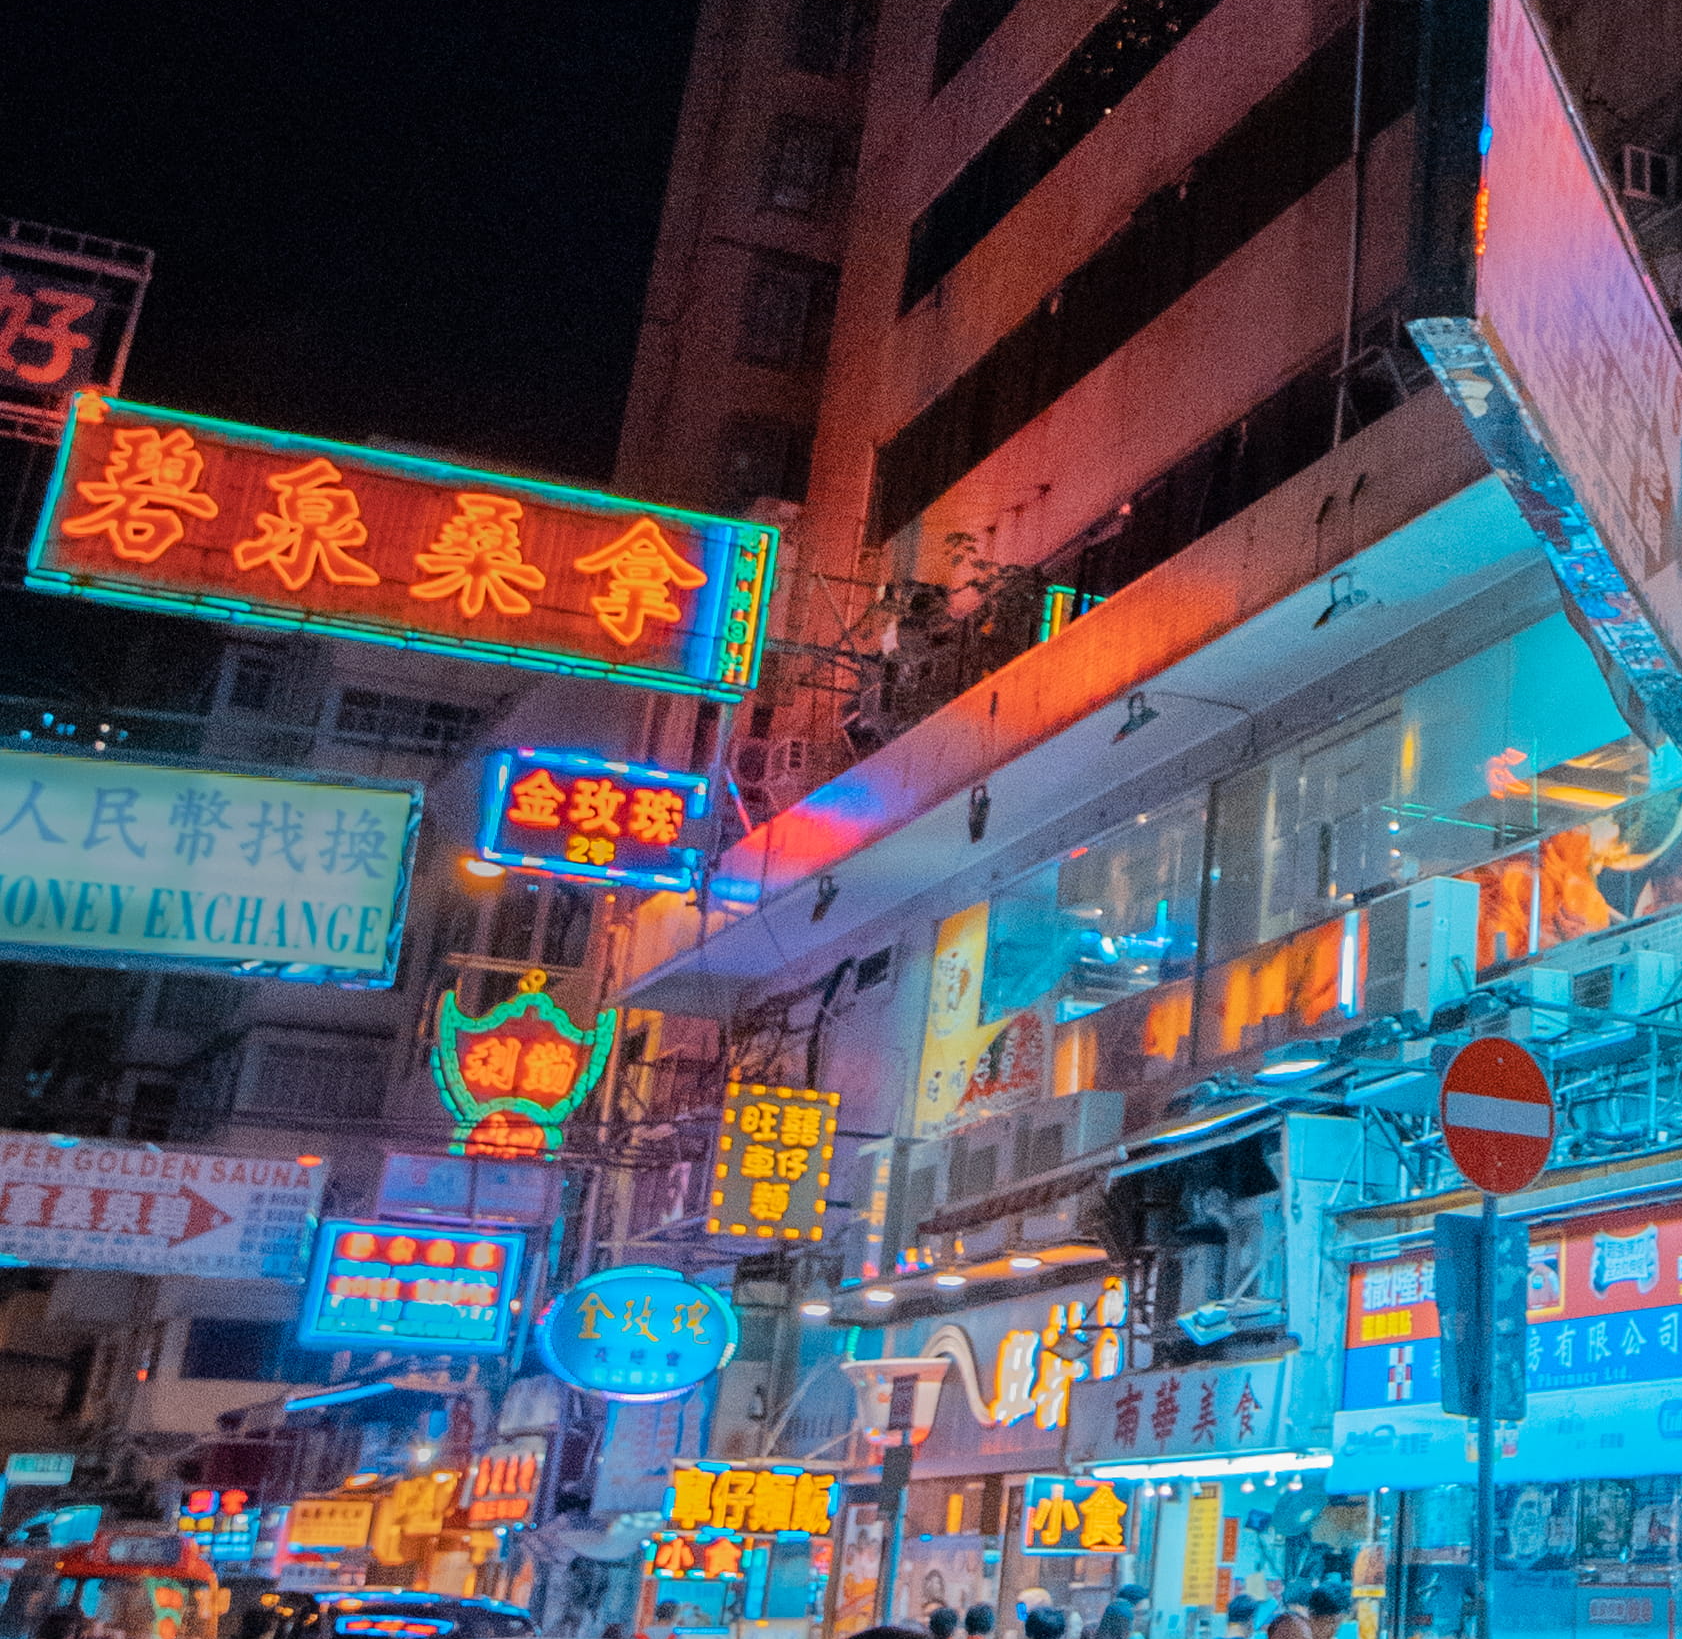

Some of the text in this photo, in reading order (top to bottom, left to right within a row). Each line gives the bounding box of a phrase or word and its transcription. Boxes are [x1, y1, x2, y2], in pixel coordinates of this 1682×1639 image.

[1, 780, 390, 878] 人民幣找換
[0, 873, 383, 956] ONEY EXCHANGE
[72, 1148, 200, 1181] GOLDEN
[210, 1159, 312, 1188] SAUNA
[740, 1144, 809, 1181] 車仔
[1032, 1484, 1128, 1548] 小食
